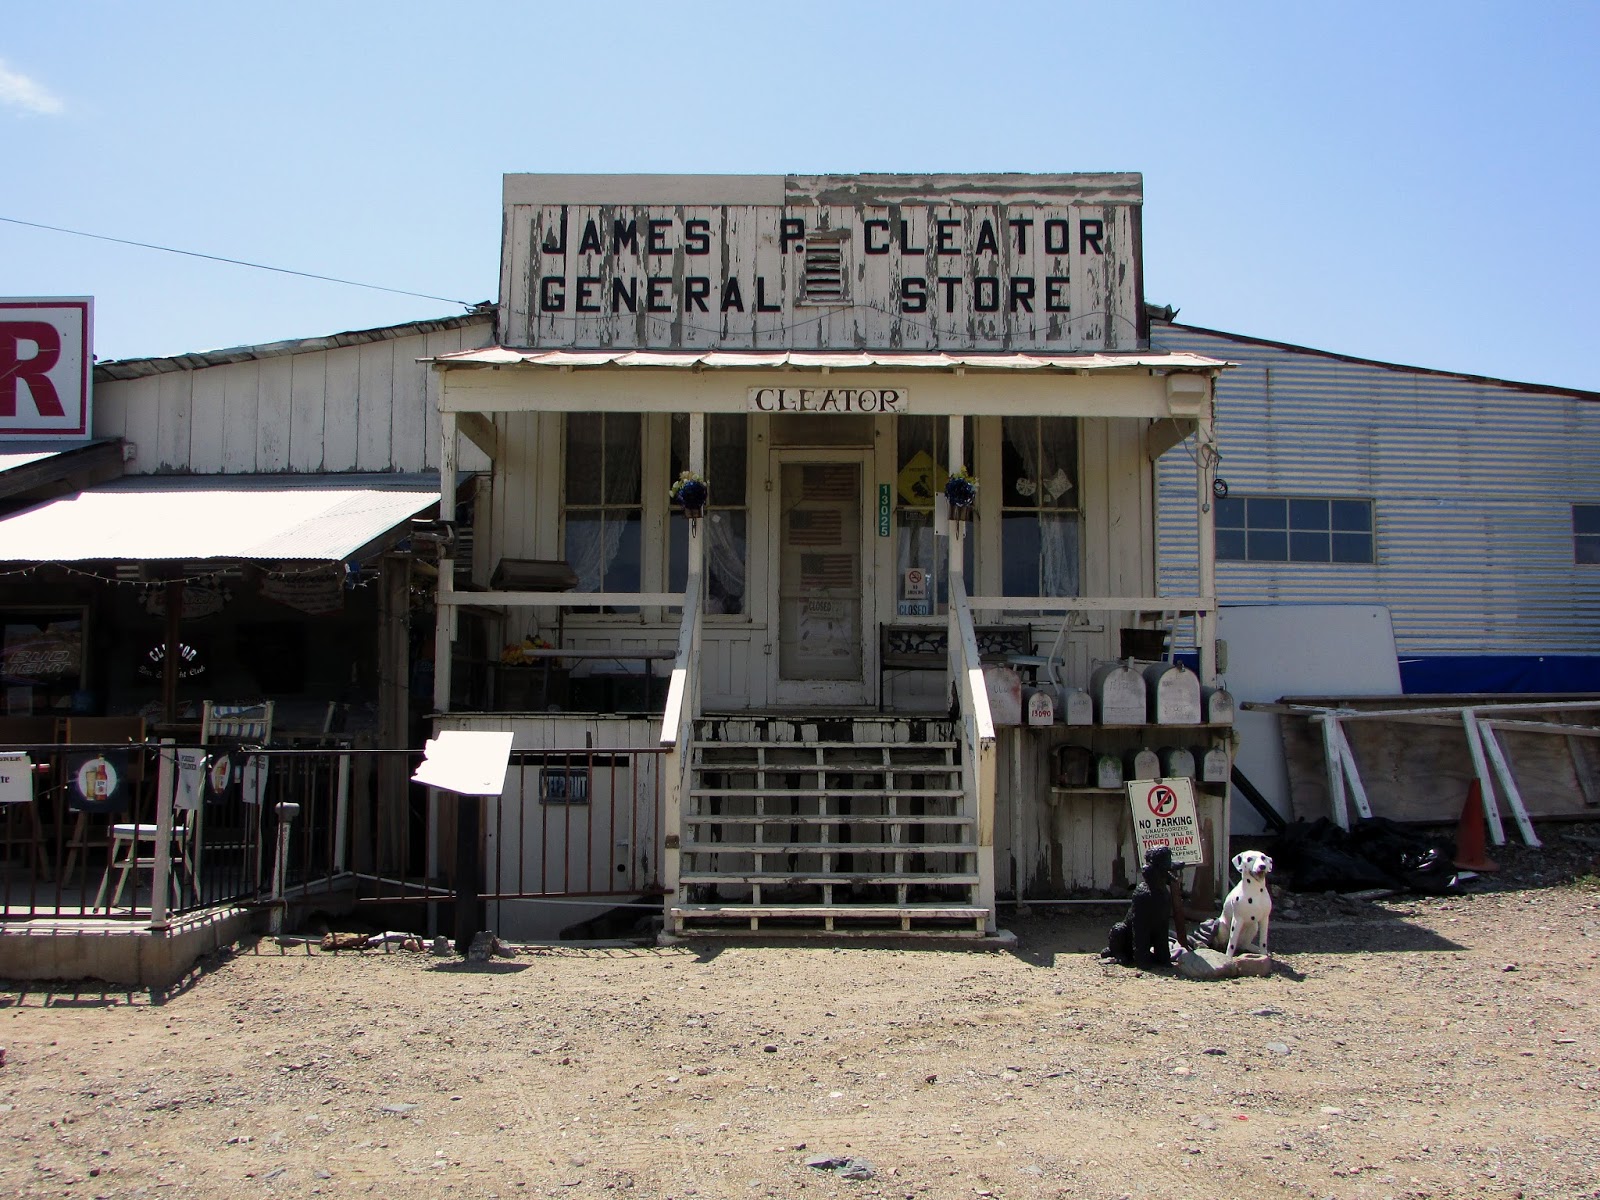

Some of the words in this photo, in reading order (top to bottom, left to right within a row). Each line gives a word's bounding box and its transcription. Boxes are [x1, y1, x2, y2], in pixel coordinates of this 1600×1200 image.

[542, 219, 710, 255] JAMES
[780, 218, 805, 255] P.
[864, 219, 1104, 255] CLEATOR
[541, 276, 781, 313] GENERAL
[901, 276, 1071, 313] STORE
[755, 388, 900, 412] CLEATOR
[880, 485, 889, 537] 13025
[808, 601, 832, 612] CLOSED
[899, 604, 927, 616] CLOSED
[8, 650, 70, 663] BUD
[149, 643, 198, 662] CLOR
[190, 664, 206, 676] Club
[1031, 710, 1052, 718] 13090
[1139, 819, 1151, 829] NO
[1156, 816, 1192, 828] PARKING
[1145, 826, 1188, 834] UNAUTHORIZED
[1143, 838, 1170, 849] TOWED
[1174, 836, 1194, 846] AWAY
